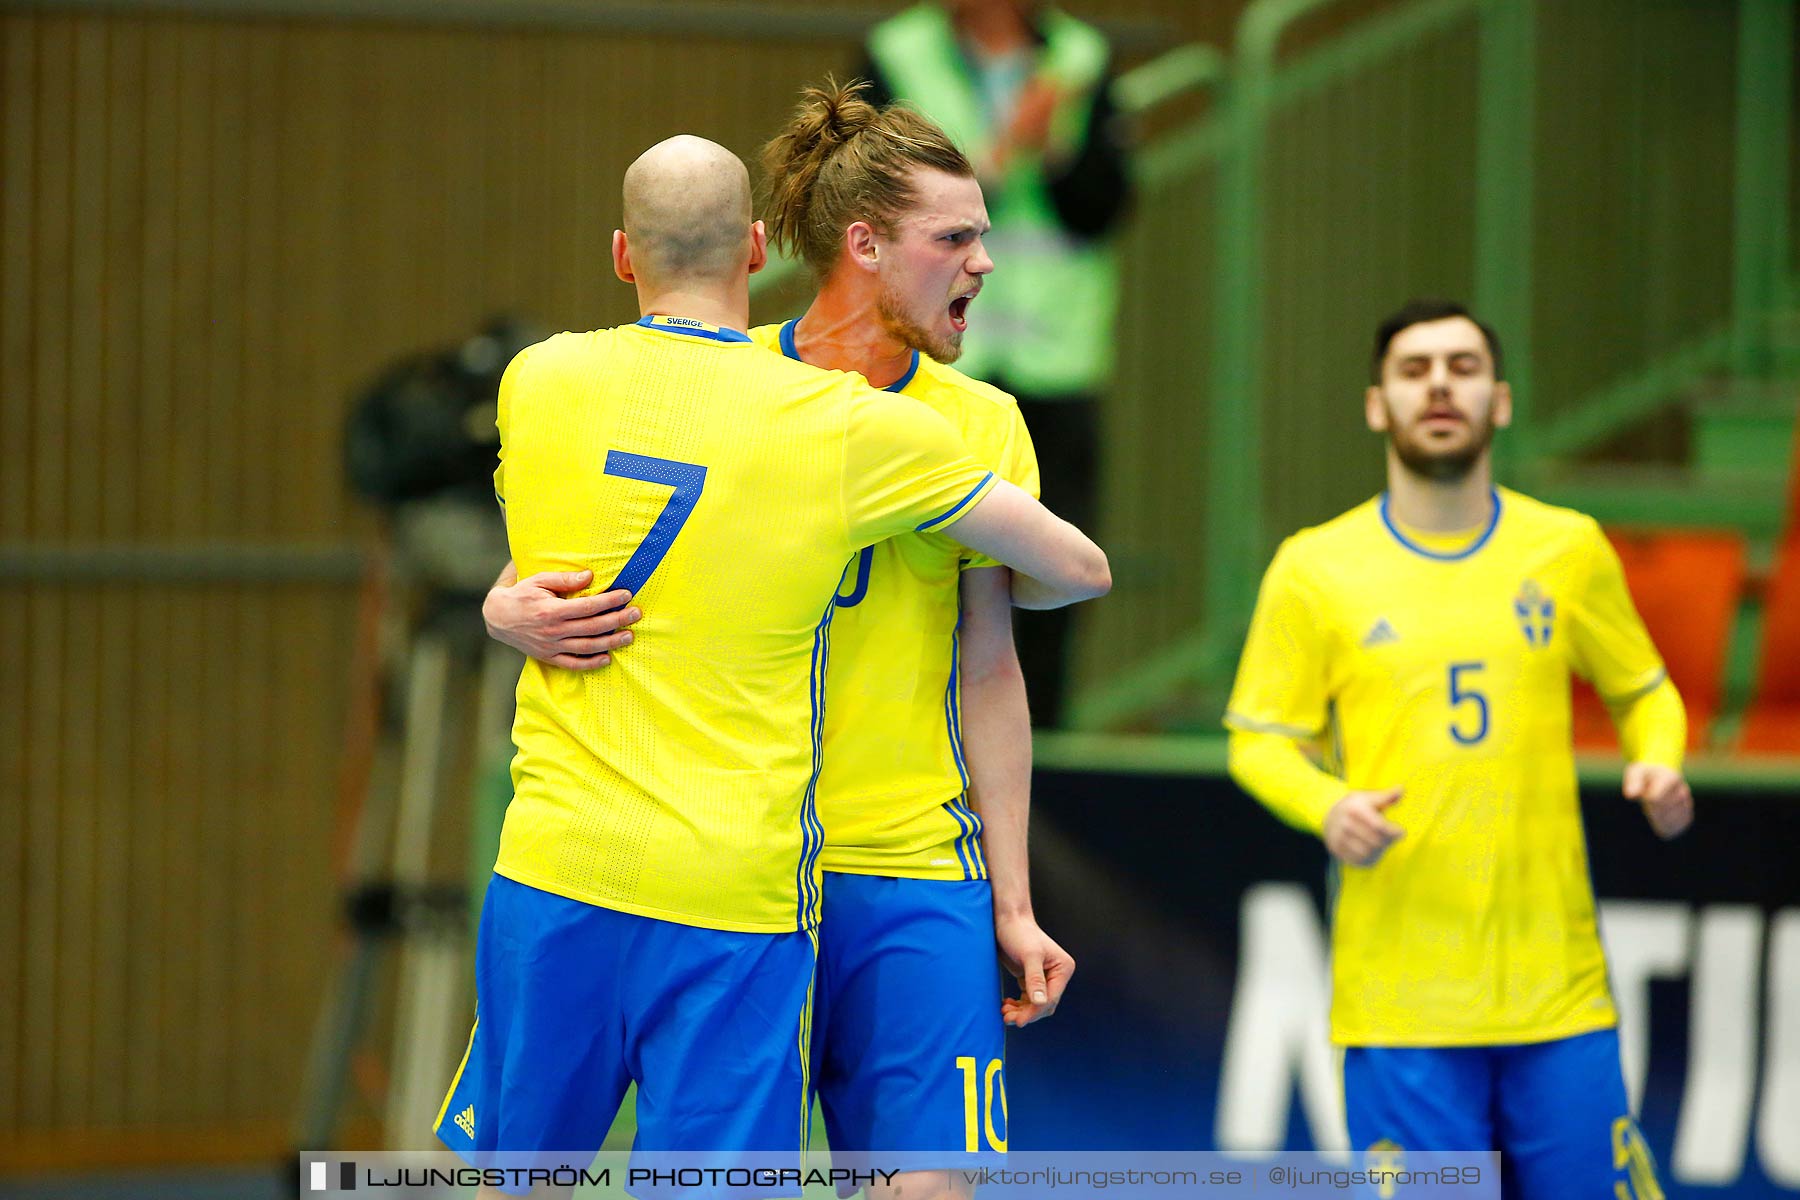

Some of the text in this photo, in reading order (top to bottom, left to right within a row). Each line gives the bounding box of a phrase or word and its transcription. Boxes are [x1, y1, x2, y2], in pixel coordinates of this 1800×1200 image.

[667, 317, 704, 328] SVERIGE
[603, 449, 708, 611] 7
[1447, 661, 1490, 746] 5
[956, 1056, 1008, 1154] 10
